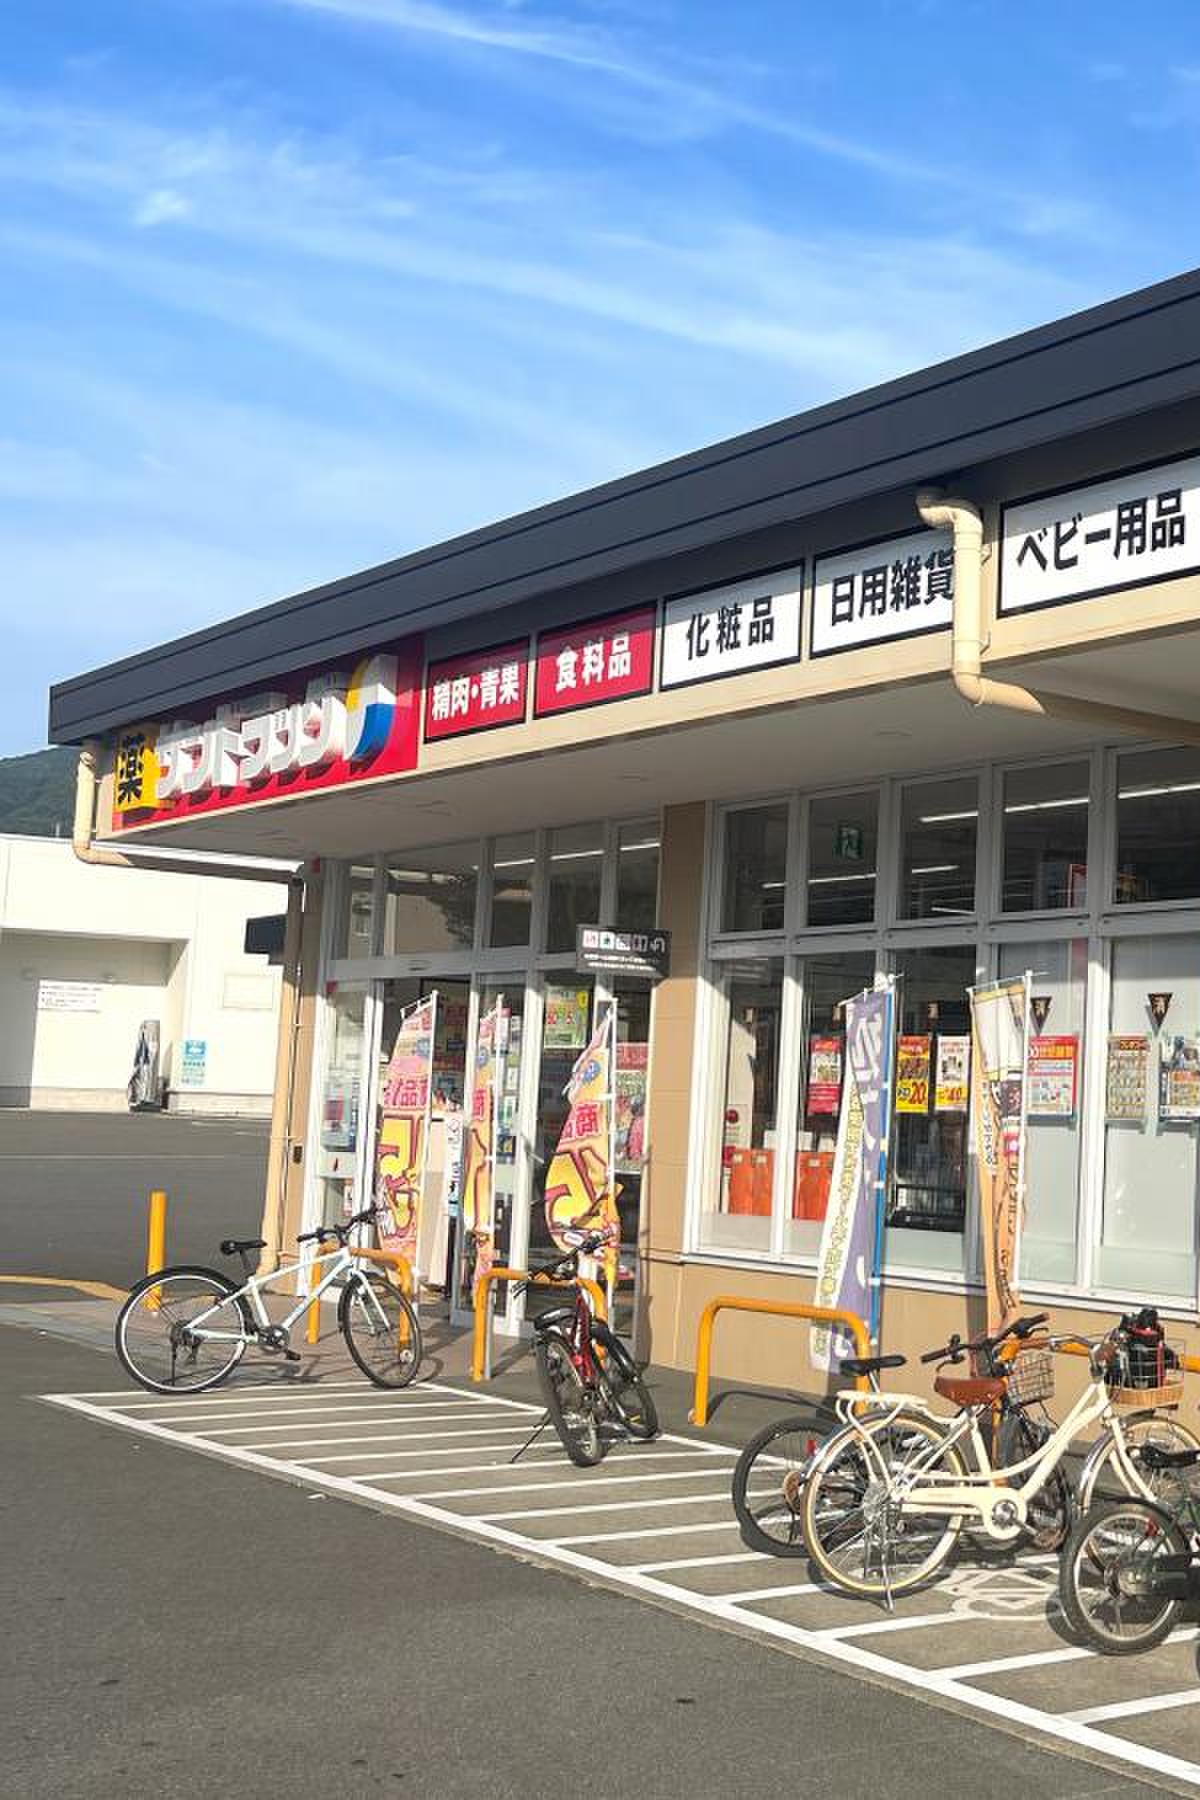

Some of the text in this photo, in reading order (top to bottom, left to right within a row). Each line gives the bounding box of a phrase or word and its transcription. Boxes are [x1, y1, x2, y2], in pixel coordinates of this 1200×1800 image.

[1016, 487, 1188, 574] ベビー用品
[829, 548, 954, 627] 日用雑貨
[554, 630, 633, 692] 食料品
[685, 595, 776, 661] 化粧品
[431, 660, 519, 721] 精肉・青果
